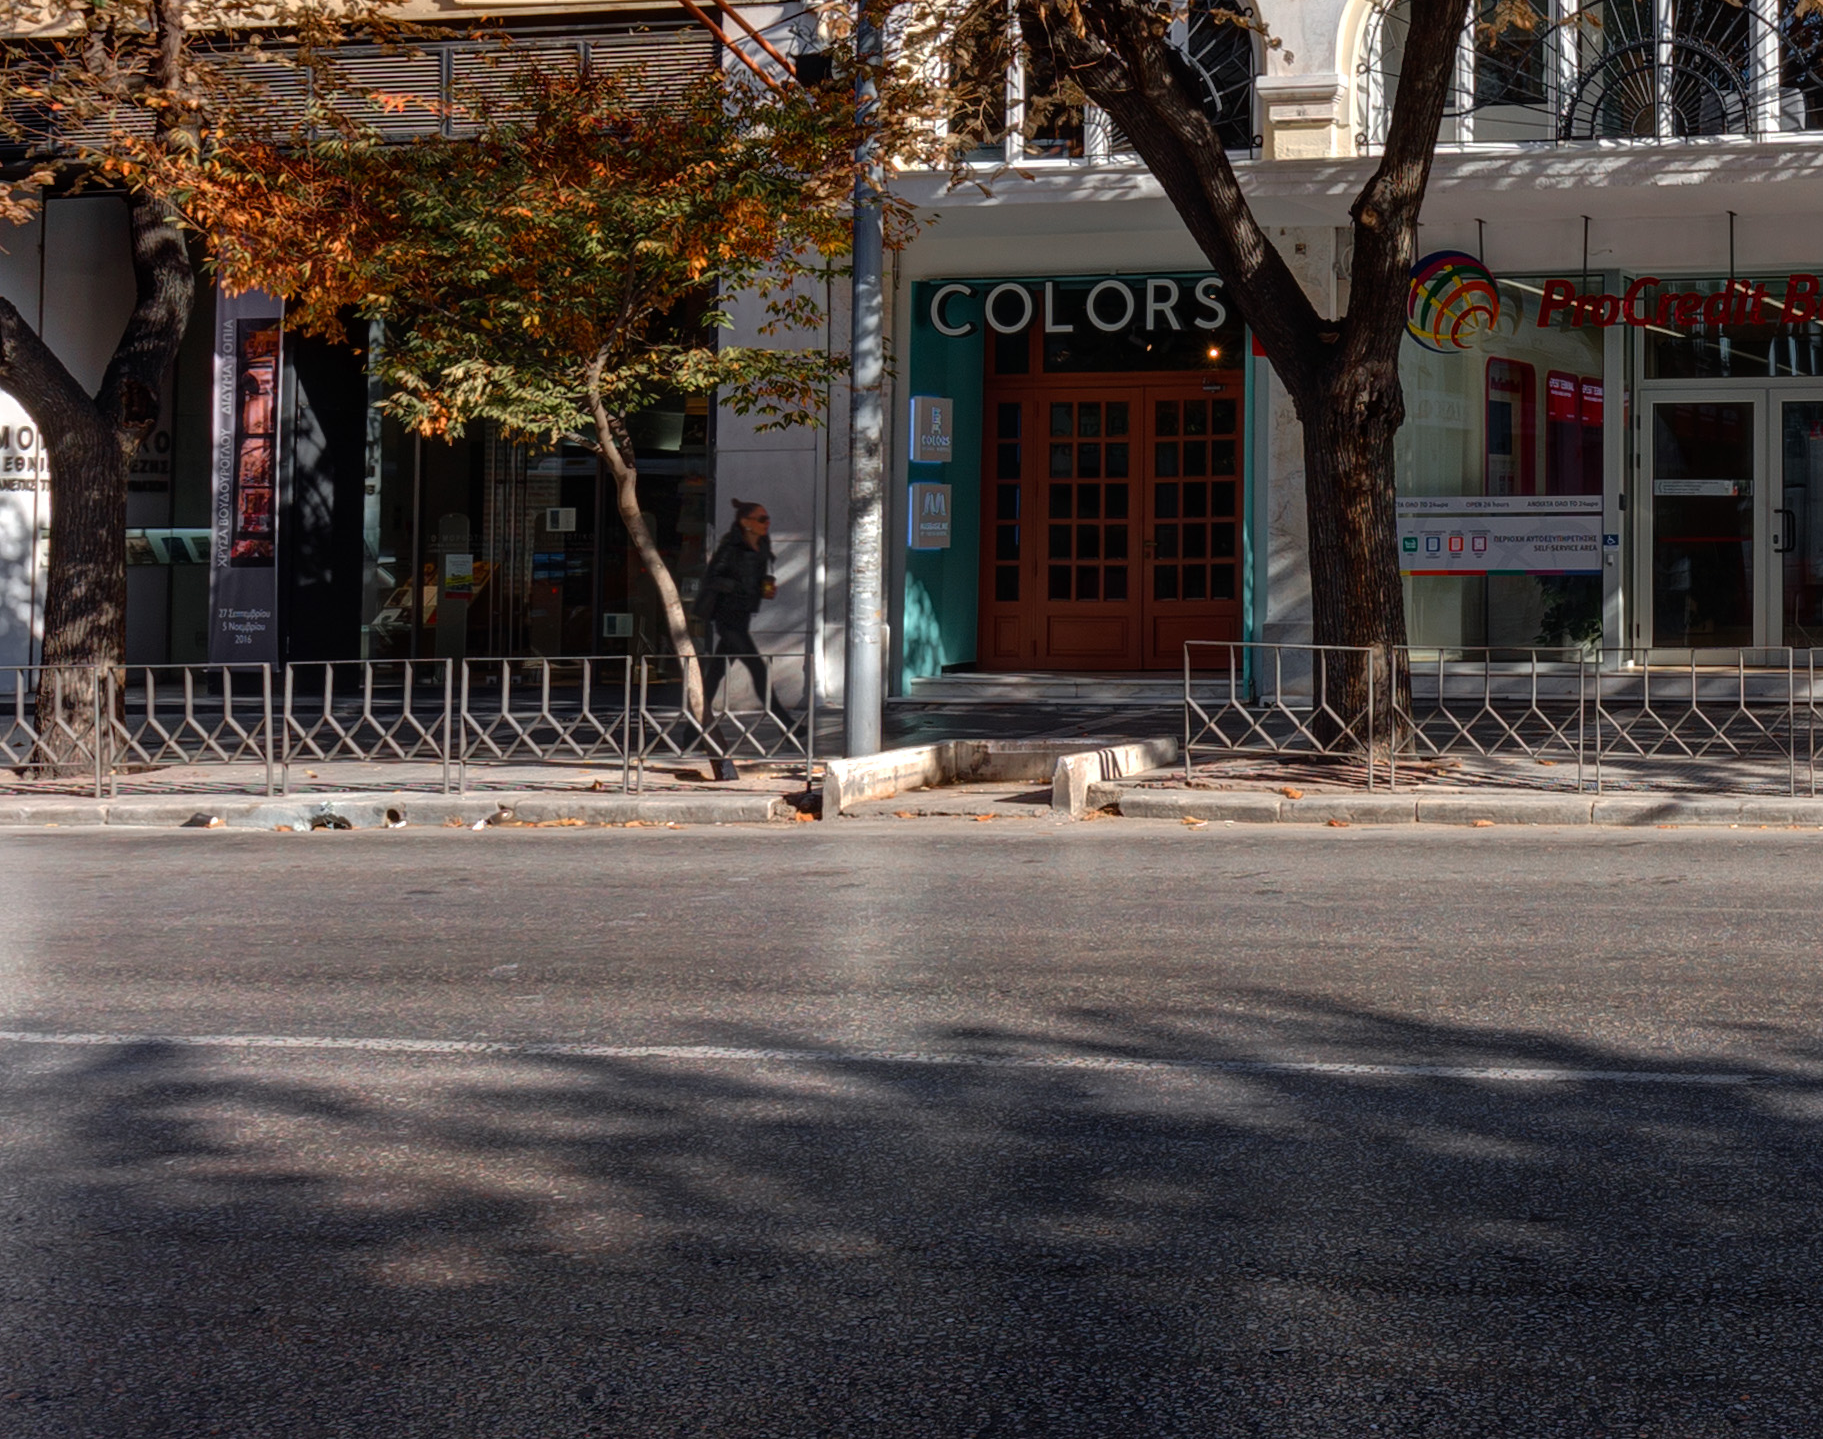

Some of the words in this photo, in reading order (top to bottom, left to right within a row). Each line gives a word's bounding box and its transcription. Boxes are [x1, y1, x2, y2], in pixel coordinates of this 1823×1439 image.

[930, 276, 1227, 337] COLORS
[1536, 276, 1770, 328] ProCredit
[221, 364, 234, 416] ΔΙΔΥΜΑ
[218, 427, 233, 527] ΒΟΥΔΟΥΡΟΓΛΟΥ
[217, 527, 229, 568] ΧΡΥΣΑ
[218, 608, 228, 618] 27
[222, 622, 228, 631] 5
[234, 634, 252, 644] 2016
